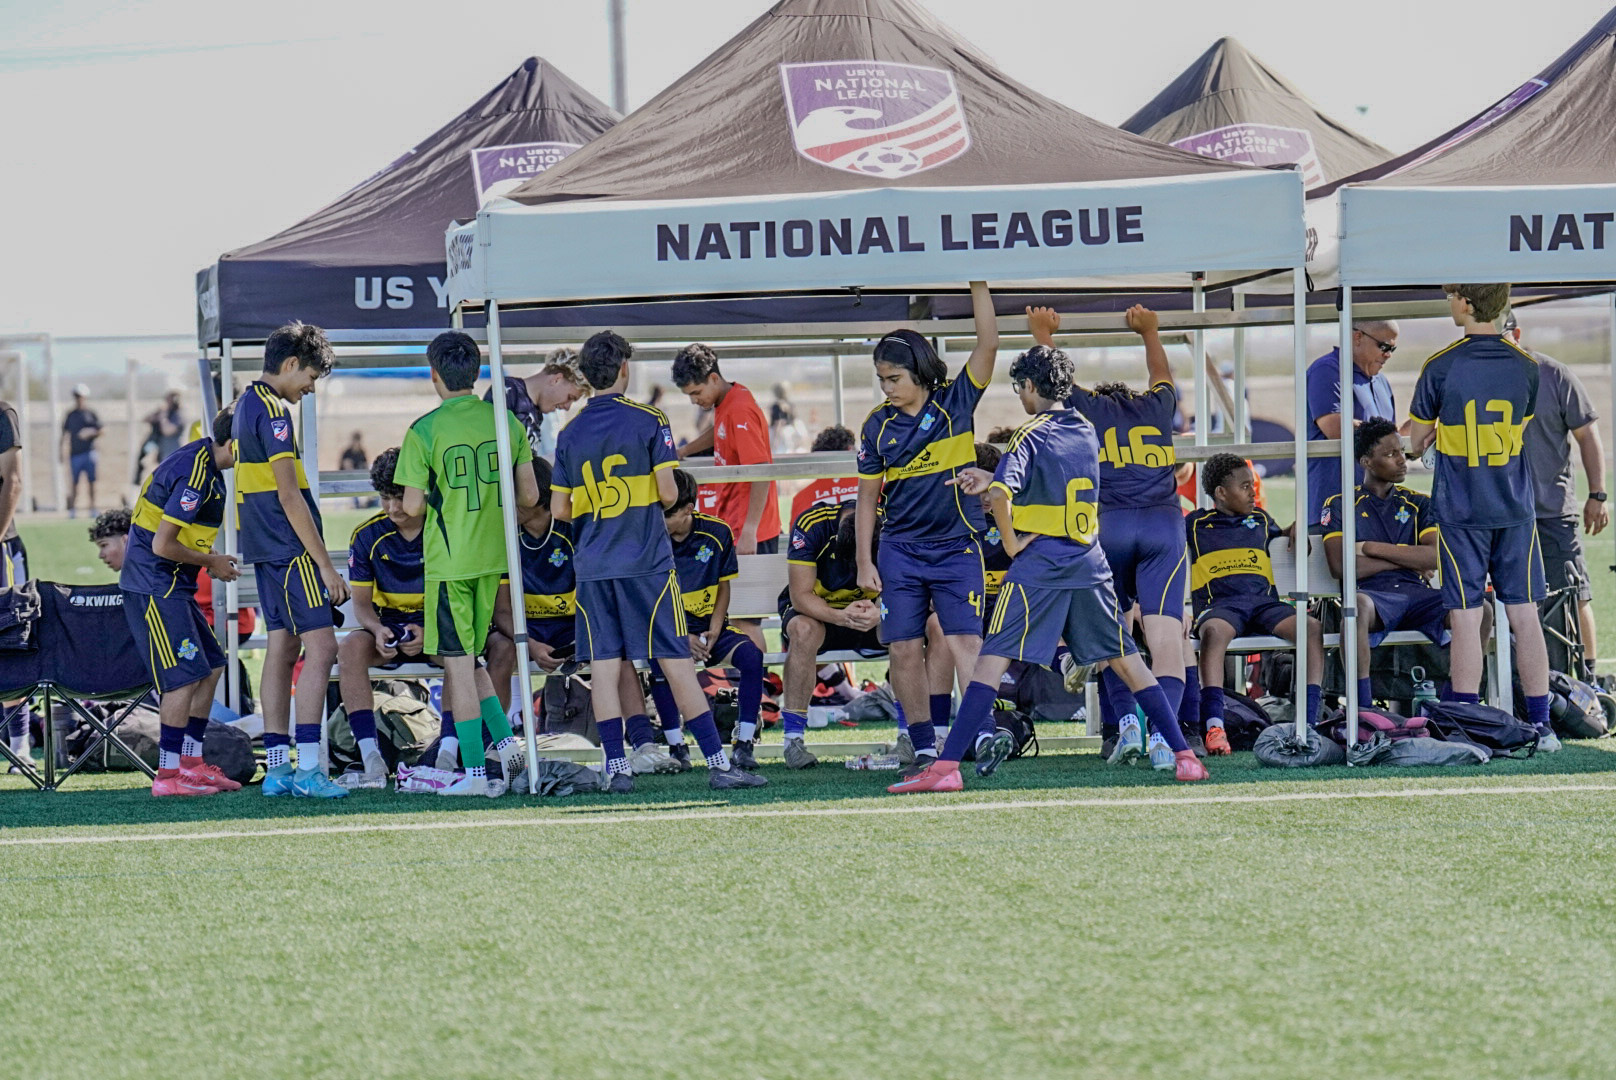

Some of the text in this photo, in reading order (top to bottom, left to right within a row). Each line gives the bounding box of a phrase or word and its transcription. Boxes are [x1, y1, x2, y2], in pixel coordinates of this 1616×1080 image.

[814, 78, 927, 92] NATIONAL
[837, 89, 910, 100] LEAGUE
[1197, 136, 1290, 155] NATIONAL
[1216, 144, 1277, 159] LEAGUE
[656, 205, 1144, 262] NATIONAL LEAGUE
[1509, 212, 1615, 252] NAT
[354, 276, 414, 310] US
[1464, 399, 1514, 468] 13
[442, 439, 503, 514] 99
[581, 453, 631, 522] 15
[815, 490, 830, 499] La
[1064, 477, 1097, 545] 6
[968, 590, 981, 616] 4
